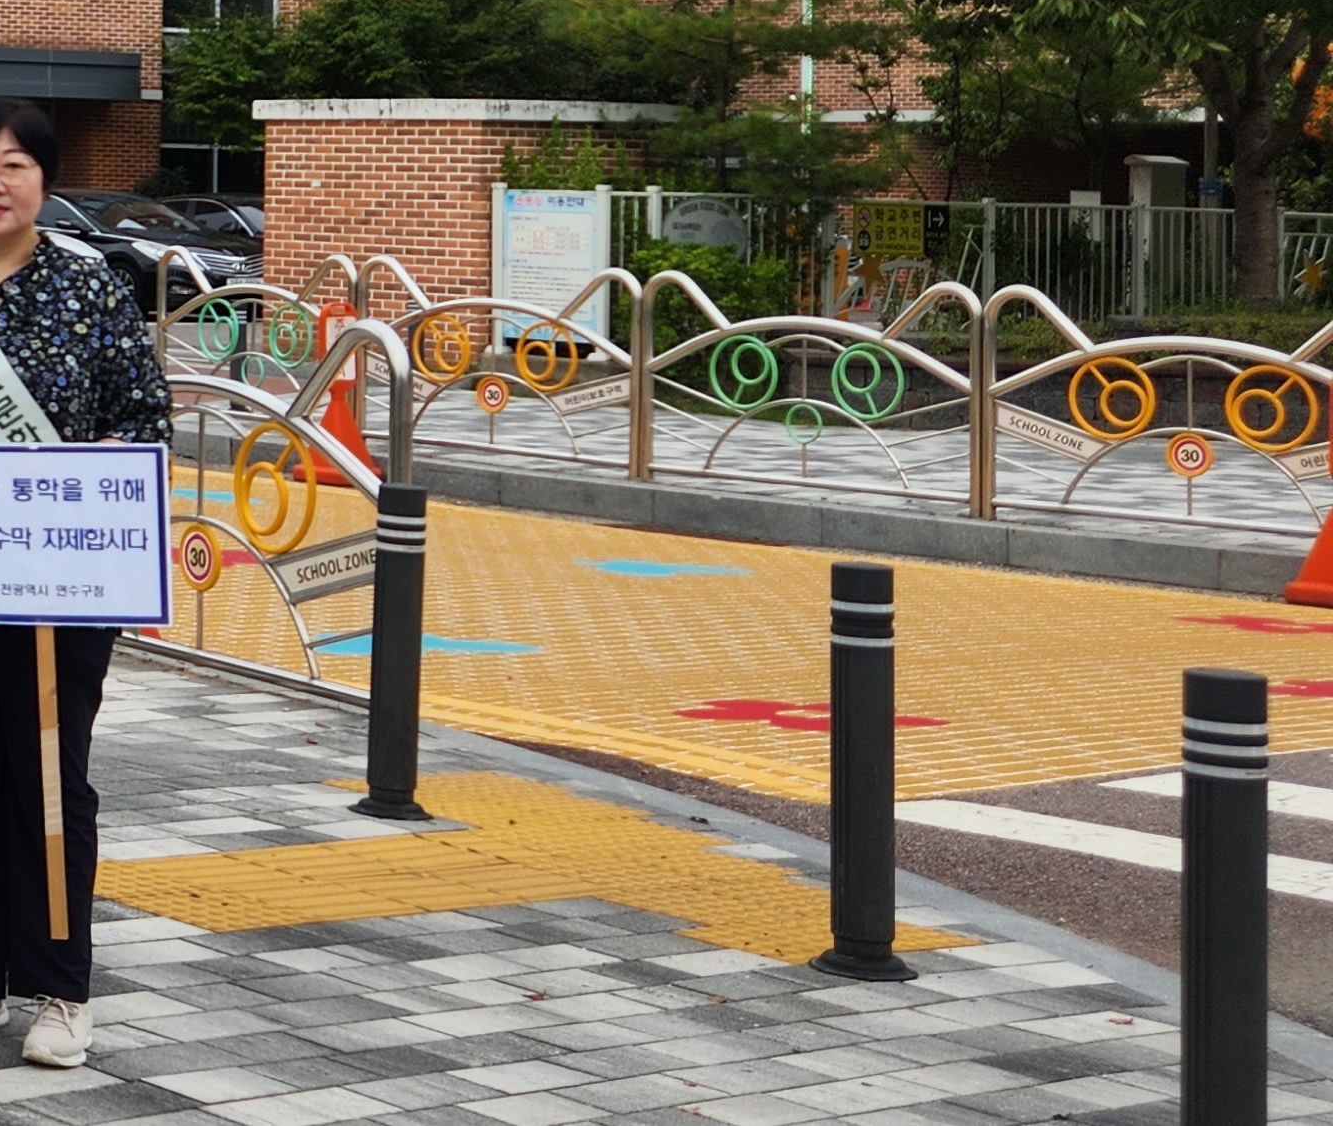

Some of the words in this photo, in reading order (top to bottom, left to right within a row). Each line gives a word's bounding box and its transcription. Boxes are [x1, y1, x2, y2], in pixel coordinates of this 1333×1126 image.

[487, 389, 500, 401] 30
[1009, 416, 1051, 440] SCHOOL
[1052, 432, 1085, 452] ZONE
[1181, 449, 1200, 463] 30
[12, 478, 82, 502] 통학을
[98, 479, 145, 502] 위해
[42, 527, 148, 552] 자제합시다
[190, 547, 206, 568] 30
[296, 559, 343, 584] SCHOOL
[345, 548, 377, 571] ZONE
